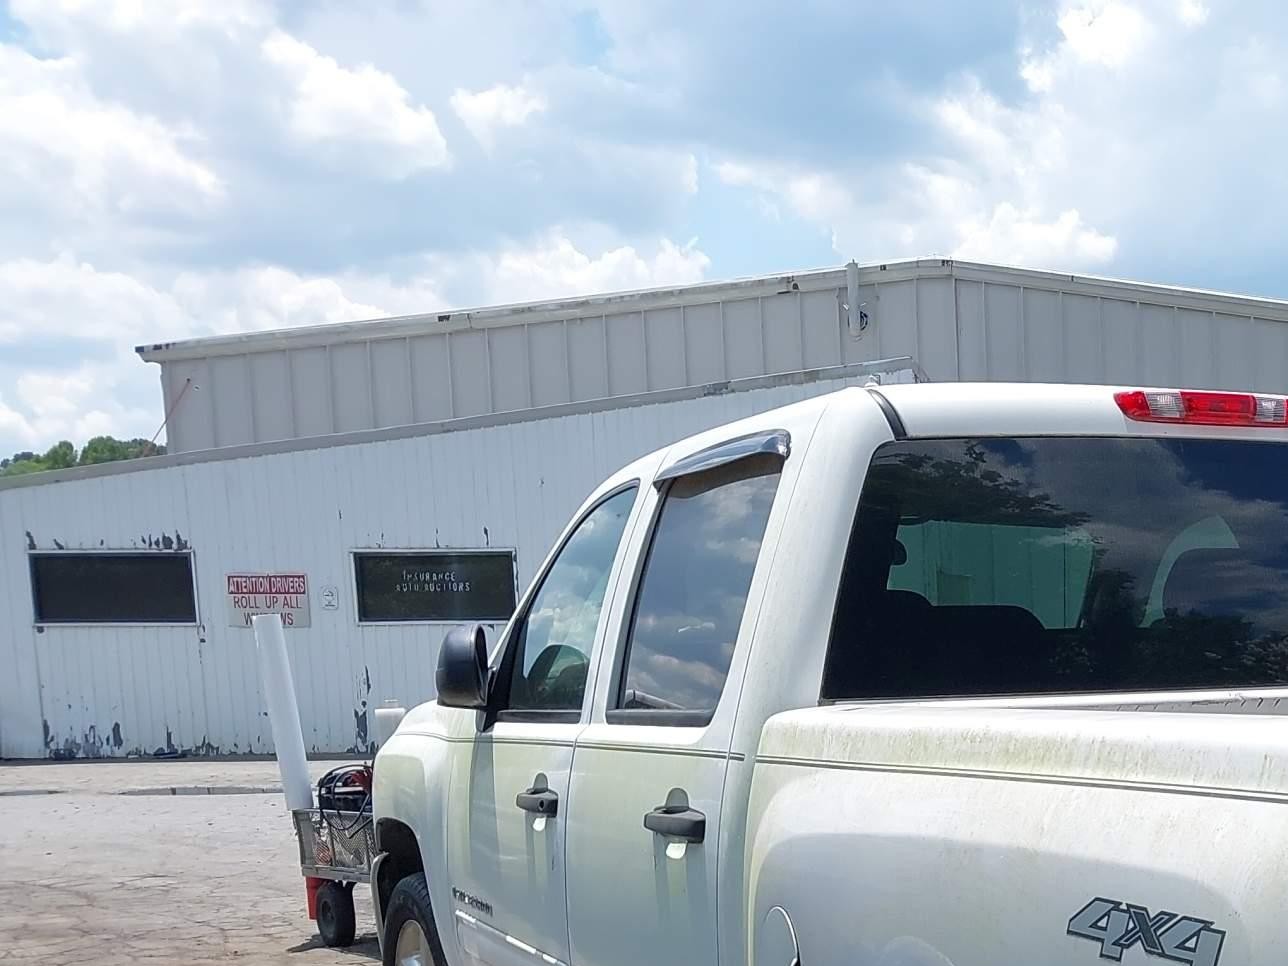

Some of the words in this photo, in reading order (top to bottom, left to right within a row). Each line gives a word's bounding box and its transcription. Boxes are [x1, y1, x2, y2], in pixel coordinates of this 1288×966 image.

[229, 577, 270, 593] ATTENTION
[271, 576, 305, 593] DRIVERS
[233, 596, 260, 608] ROLL
[265, 596, 279, 608] UP
[283, 595, 302, 608] ALL
